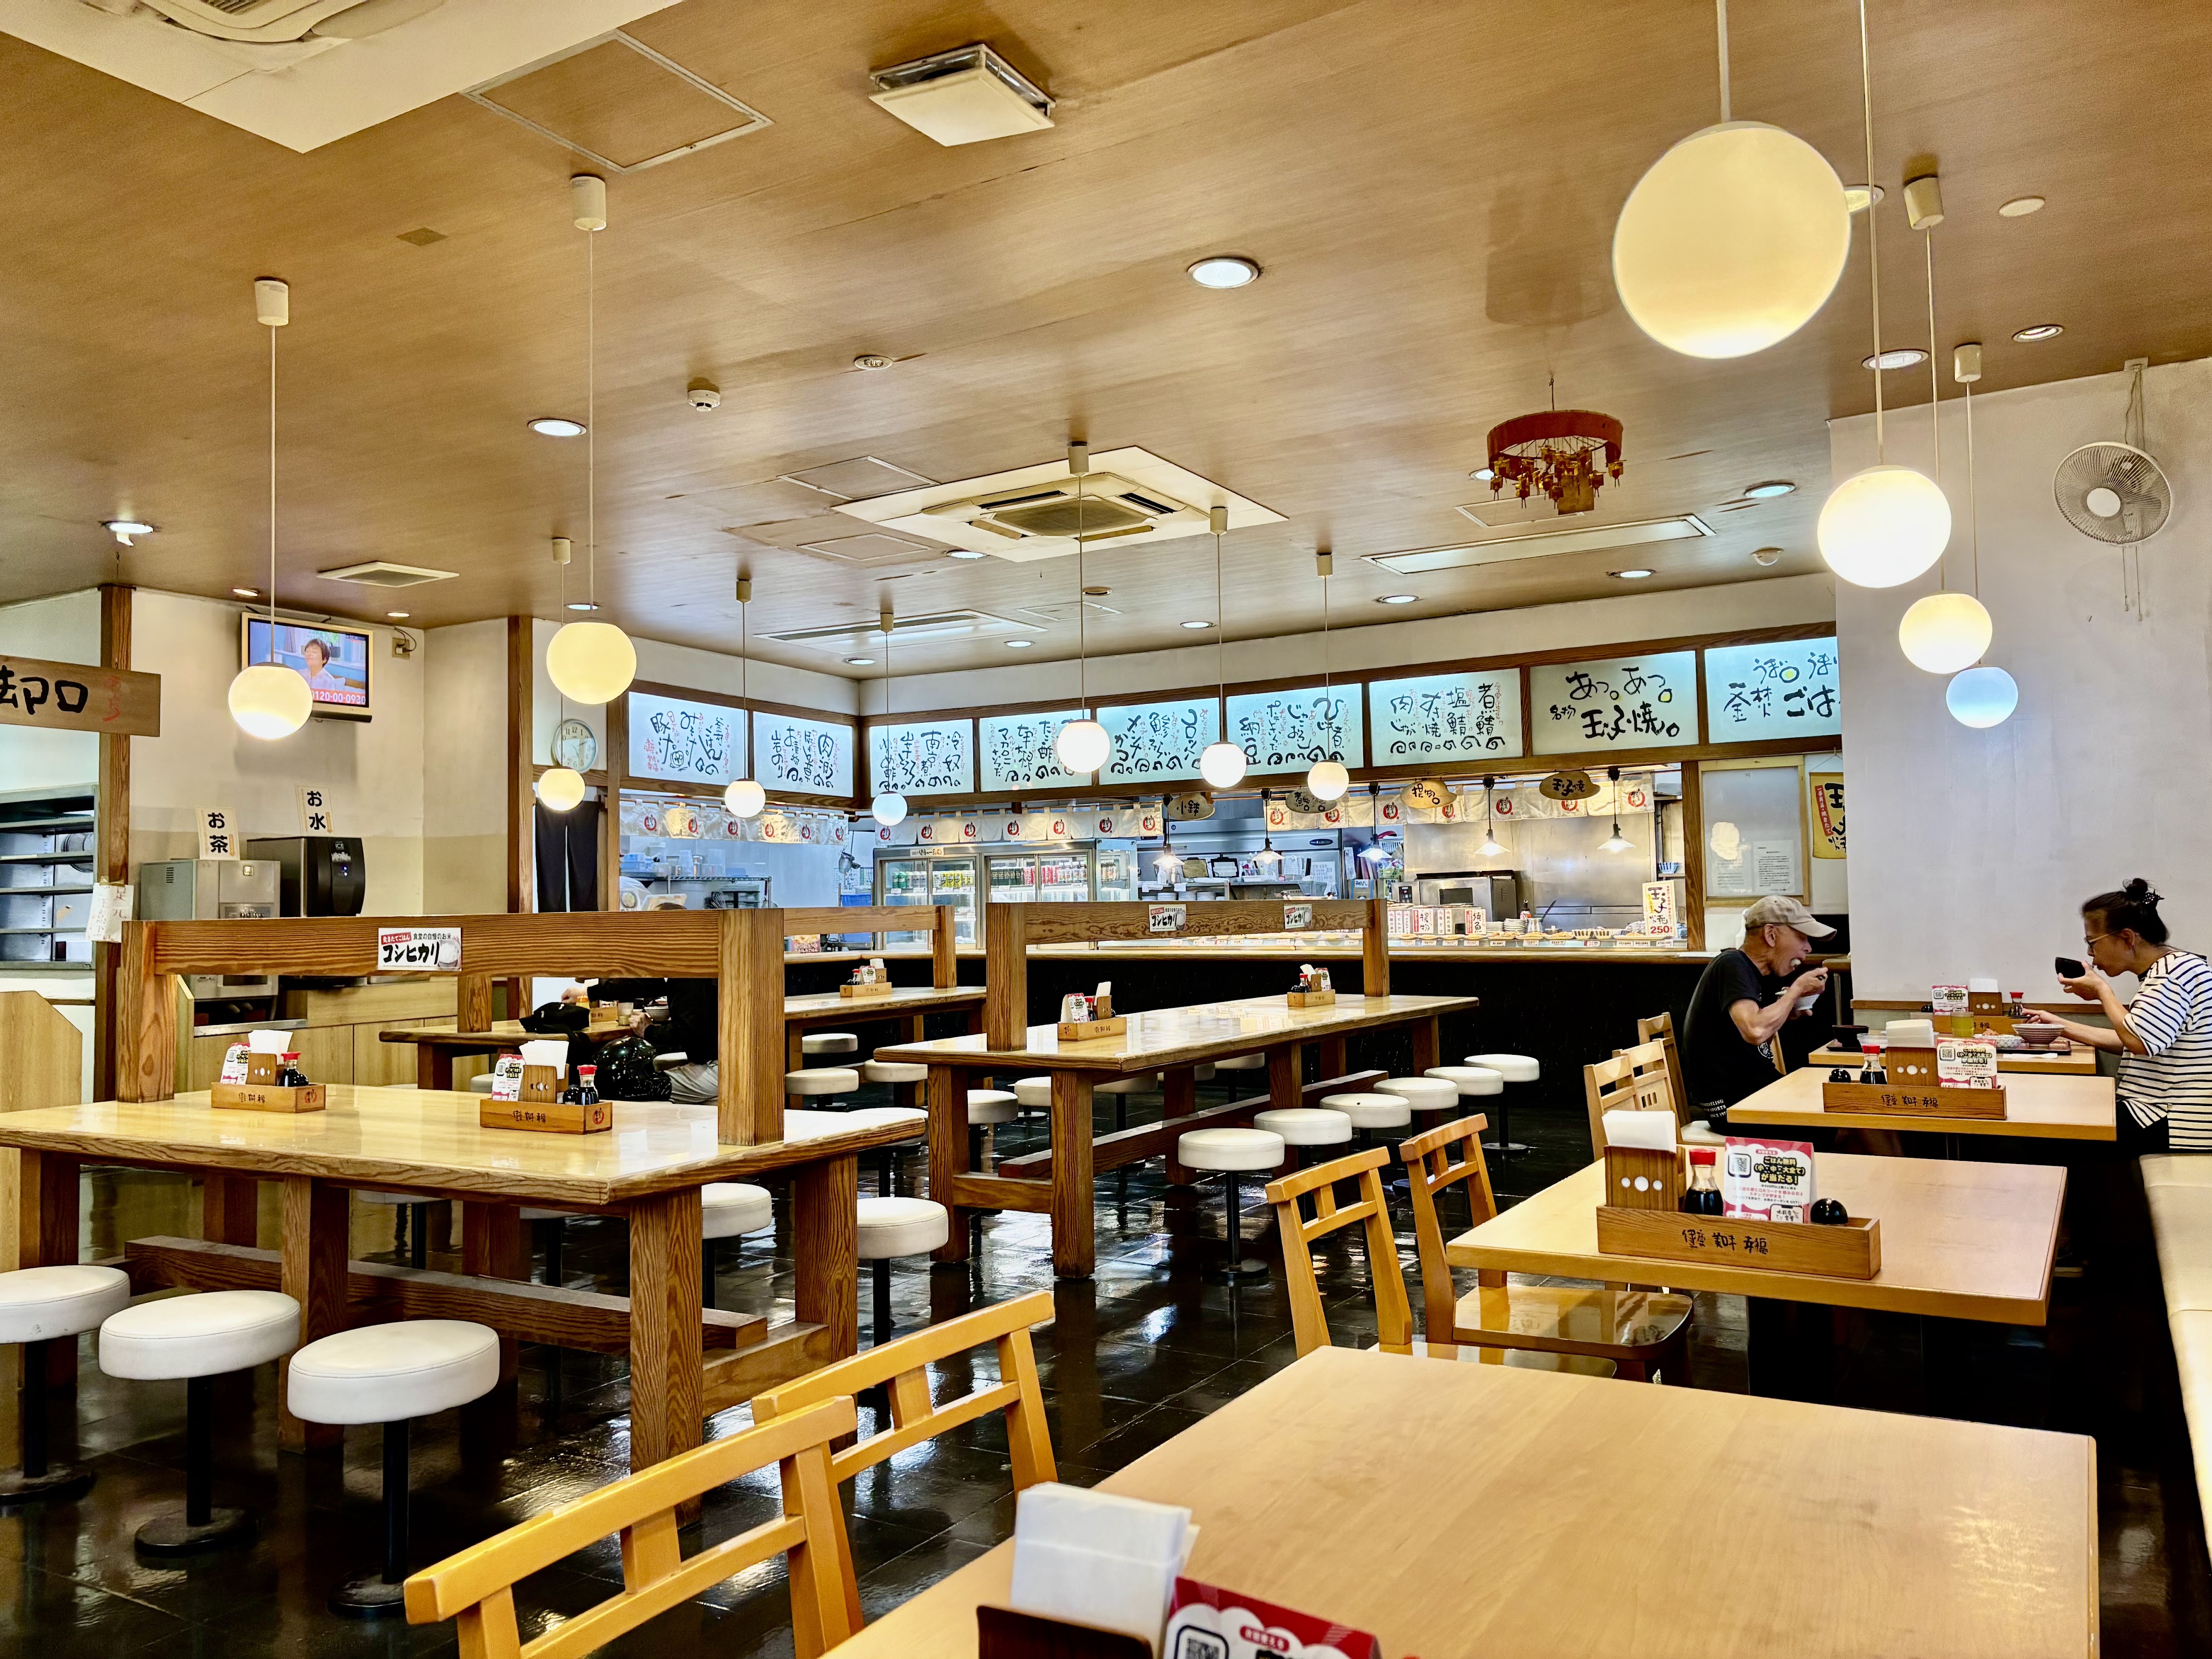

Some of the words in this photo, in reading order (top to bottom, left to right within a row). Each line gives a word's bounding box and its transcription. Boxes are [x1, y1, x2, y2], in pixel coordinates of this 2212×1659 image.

[307, 791, 326, 830] お水
[207, 812, 229, 853] お茶
[1152, 913, 1177, 927] コシヒカリ
[1286, 912, 1305, 925] コシヒカリ
[1650, 925, 1670, 934] 250
[383, 941, 440, 965] コシヒカリ
